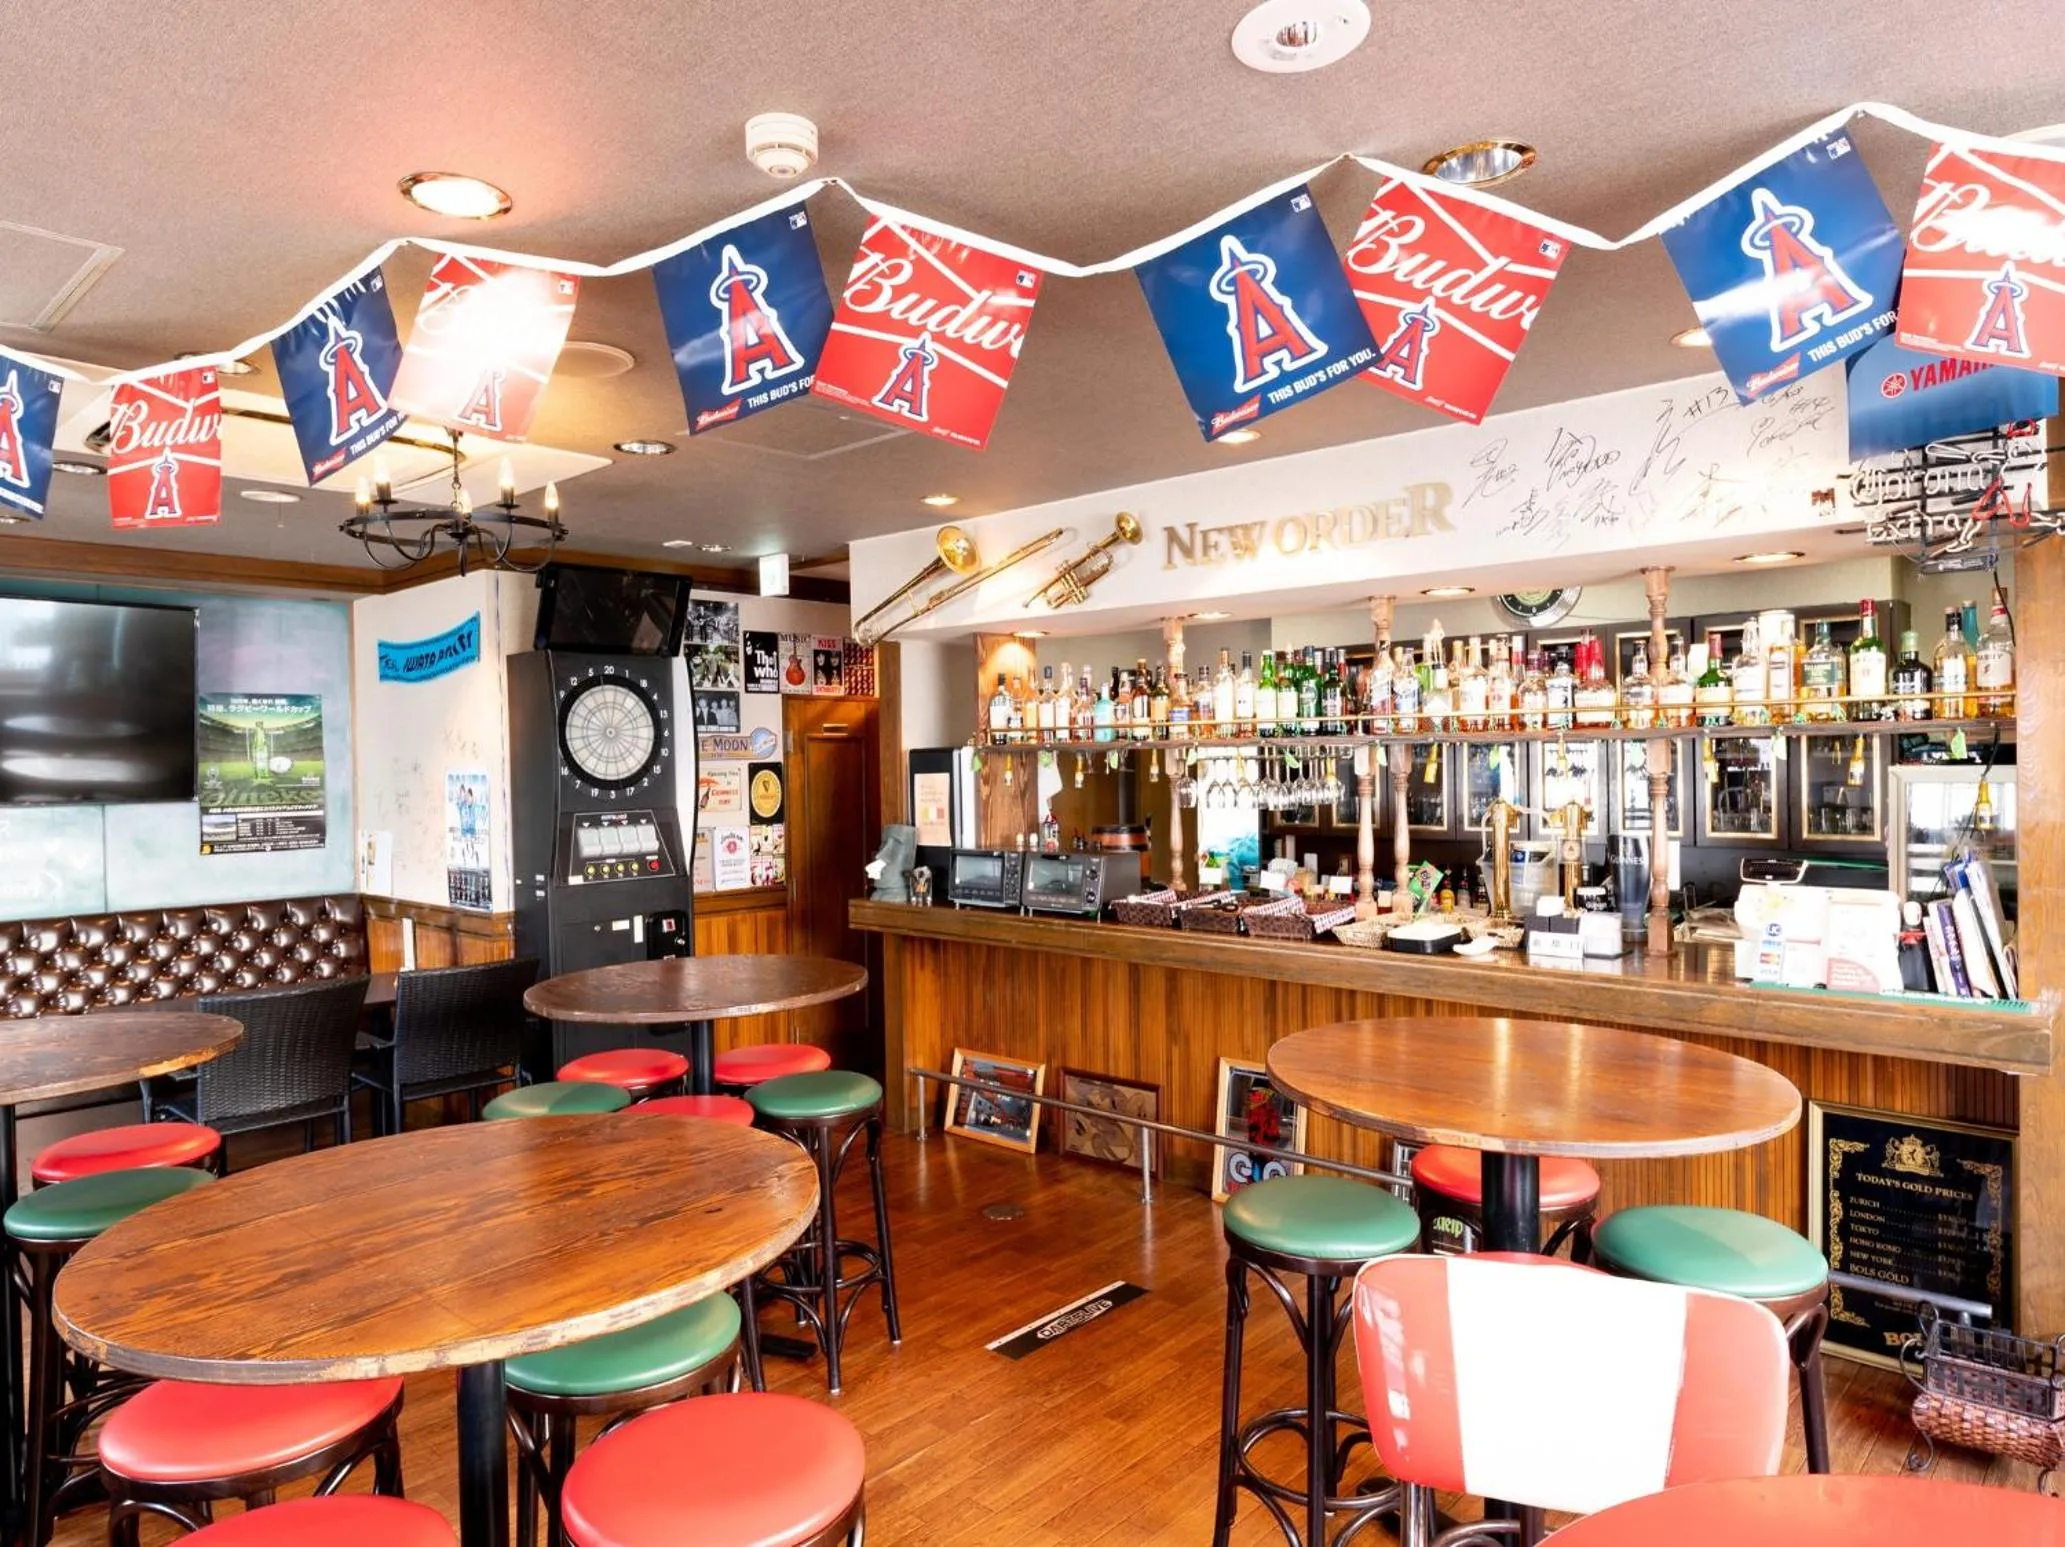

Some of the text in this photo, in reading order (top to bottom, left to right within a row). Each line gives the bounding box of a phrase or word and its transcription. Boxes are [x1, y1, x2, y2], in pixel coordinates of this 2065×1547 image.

[1806, 341, 1838, 362] THIS
[1835, 322, 1874, 348] BUD'S
[1267, 347, 1376, 404] THIS BUD'S FOR YOU.
[747, 392, 769, 408] THIS
[770, 381, 798, 401] BUD'S
[1851, 466, 1989, 506] Corona
[1162, 521, 1268, 572] NEW
[1273, 481, 1456, 556] ORDER
[1866, 510, 1963, 543] Extra
[713, 738, 749, 751] MOON
[1856, 1172, 1973, 1200] TODAY'S GOLD PRICES
[1849, 1209, 1885, 1222] LONDON
[1849, 1223, 1879, 1236] TOKYO
[1849, 1263, 1910, 1285] BOLS GOLD
